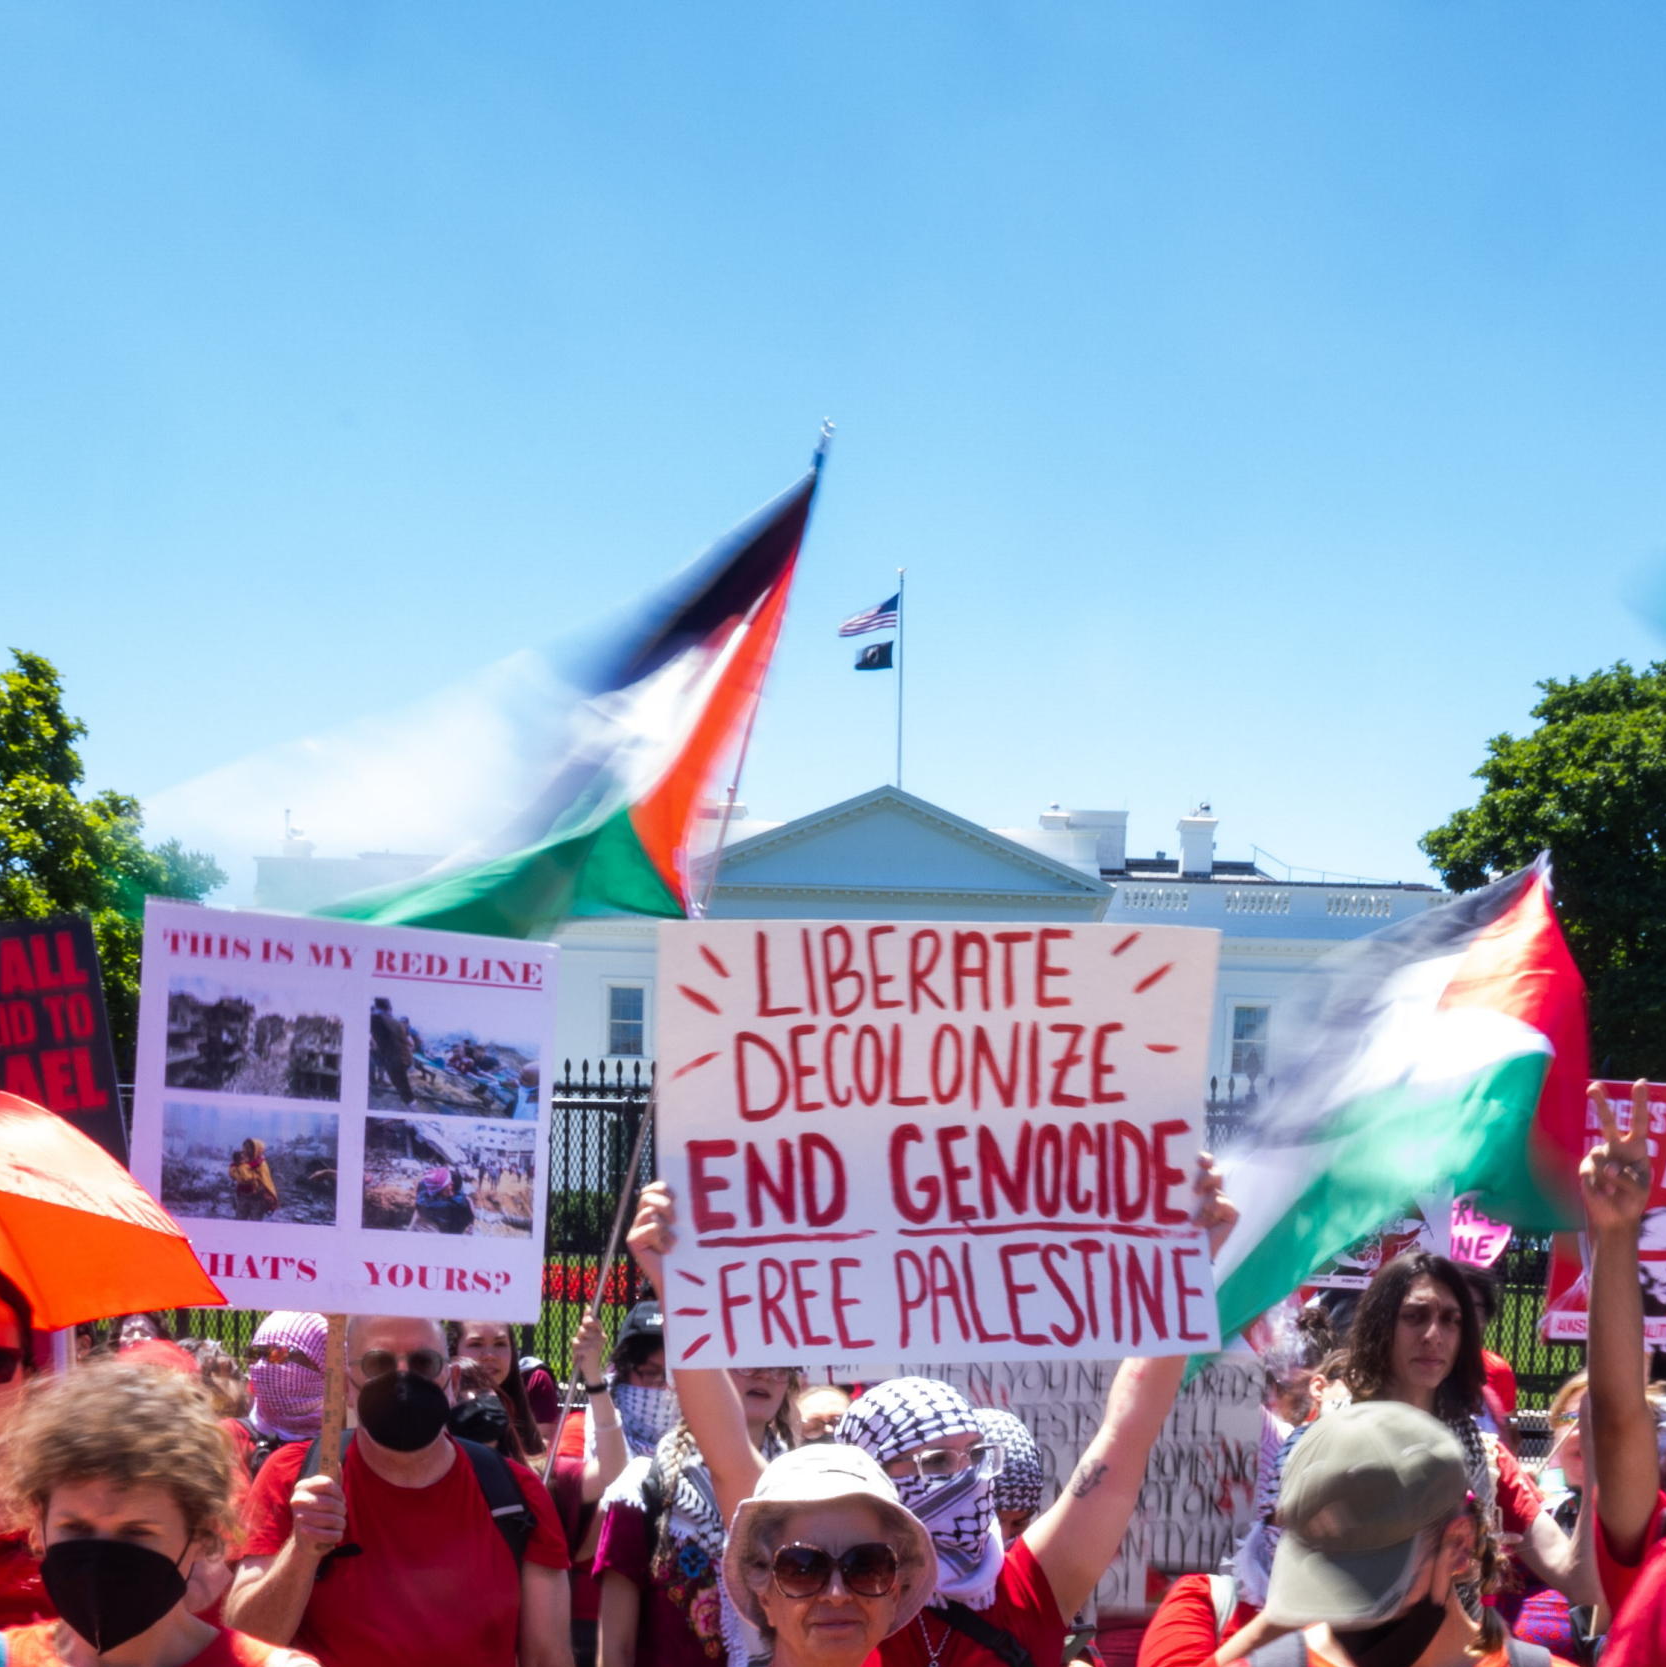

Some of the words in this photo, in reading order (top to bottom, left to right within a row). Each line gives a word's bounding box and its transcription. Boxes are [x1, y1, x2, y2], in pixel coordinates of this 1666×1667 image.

[162, 929, 252, 962] THIS
[259, 938, 292, 965] IS
[306, 943, 359, 971] MY
[373, 949, 450, 979] RED
[458, 956, 544, 986] LINE
[757, 925, 1073, 1018] LIBERATE
[42, 991, 94, 1038] TO
[735, 1022, 1126, 1122] DECOLONIZE
[687, 1132, 847, 1233] END
[889, 1119, 1193, 1227] GENOCIDE
[363, 1260, 511, 1295] YOURS?
[719, 1256, 875, 1358] FREE
[894, 1238, 1208, 1350] PALESTINE
